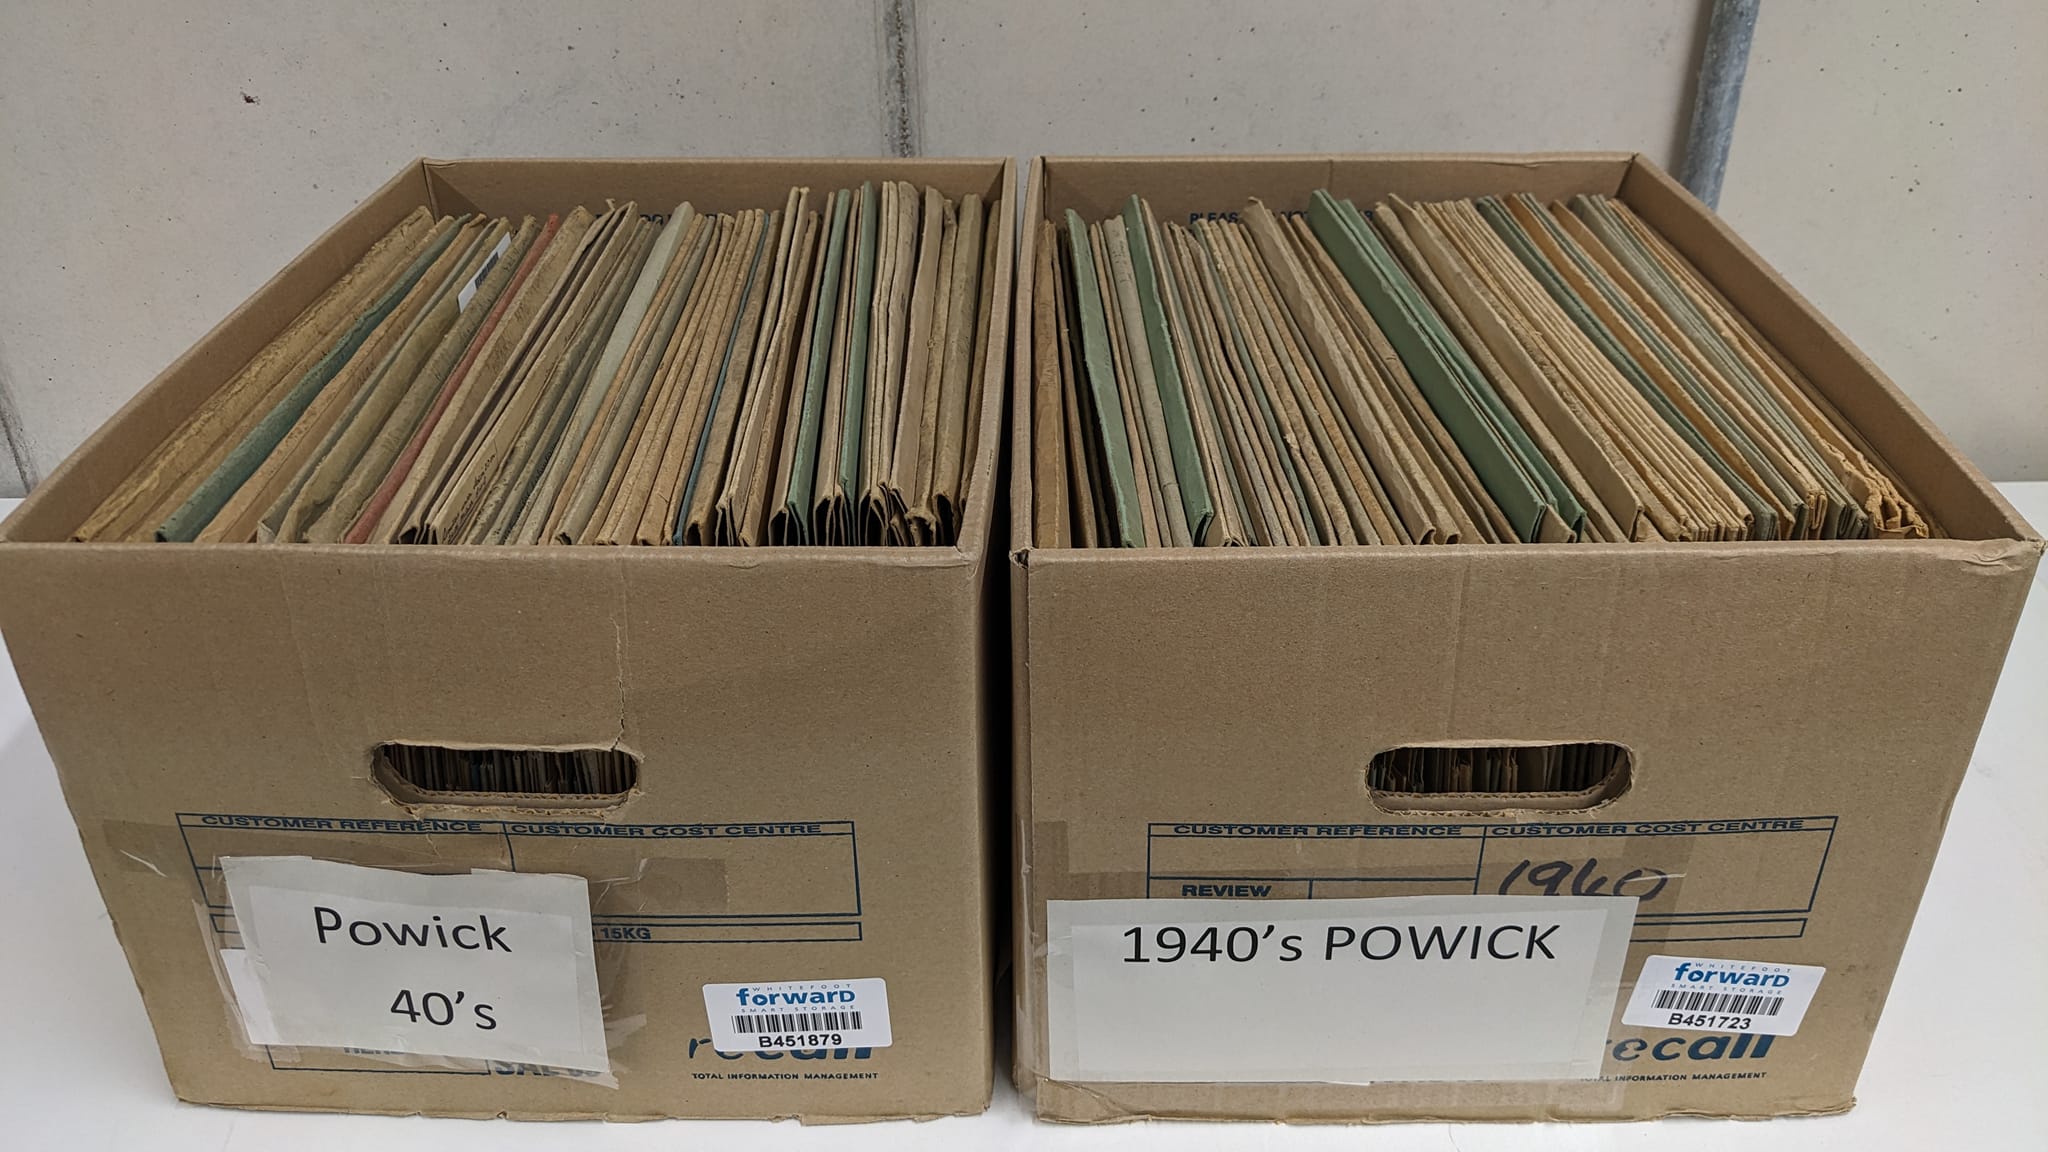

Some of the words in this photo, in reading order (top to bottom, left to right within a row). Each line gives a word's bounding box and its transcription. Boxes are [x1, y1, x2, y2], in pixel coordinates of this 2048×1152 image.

[201, 815, 337, 830] CUSTOMER
[340, 818, 483, 832] REFERENCE
[510, 823, 645, 836] CUSTOMER
[651, 823, 719, 836] COST
[724, 823, 822, 835] CENTRE
[1491, 823, 1627, 836] CUSTOMER
[1634, 822, 1703, 834] COST
[1707, 819, 1806, 832] CENTRE
[1173, 824, 1309, 836] CUSTOMER
[1316, 825, 1462, 837] REFERENCE
[1181, 884, 1272, 897] REVIEW
[313, 905, 513, 953] Powick
[601, 927, 652, 940] 15KG
[1122, 924, 1303, 963] 1940's
[1324, 924, 1561, 961] POWICK
[1695, 963, 1791, 973] WHITEFOOT
[753, 983, 851, 992] WHITEFOOT
[1723, 986, 1783, 995] STORAGE
[390, 989, 497, 1030] 40's
[794, 1004, 854, 1012] STORAGE
[1668, 1012, 1752, 1030] B451723
[758, 1033, 843, 1049] B451879
[1606, 1032, 1777, 1062] ecall
[692, 1072, 723, 1080] TOTAL
[727, 1072, 799, 1080] INFORMATION
[804, 1072, 879, 1080] MANAGEMENT
[1615, 1073, 1687, 1082] INFORMATION
[1691, 1071, 1768, 1081] MANAGEMENT
